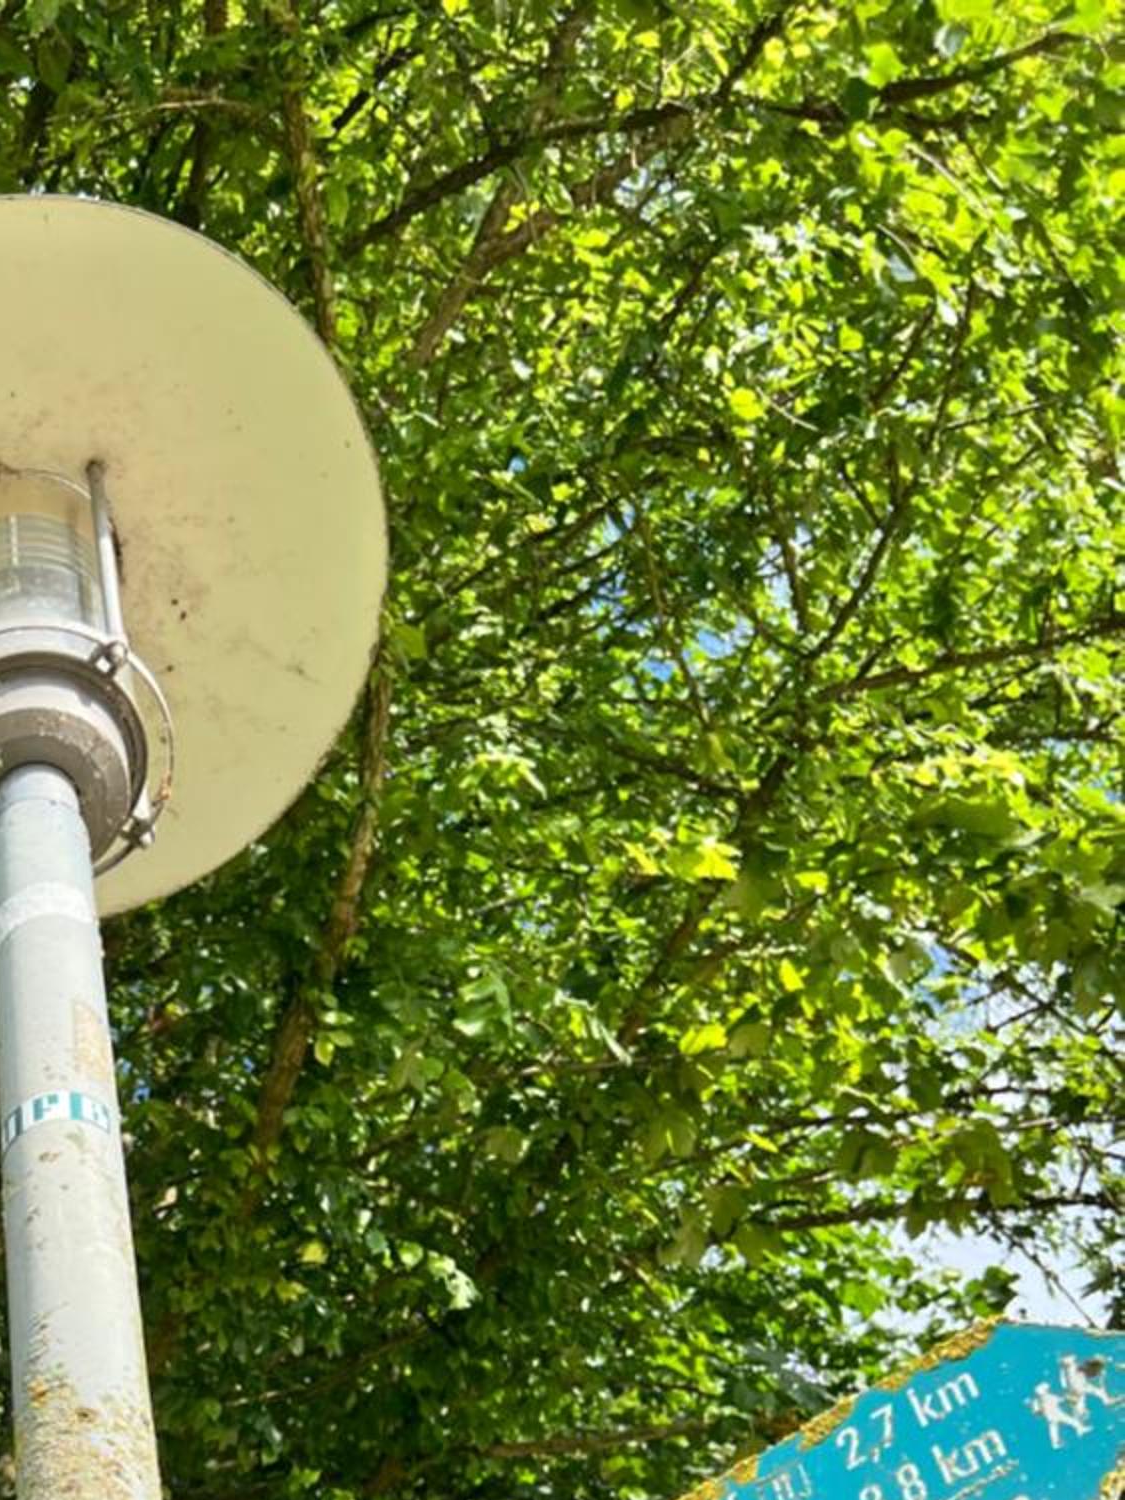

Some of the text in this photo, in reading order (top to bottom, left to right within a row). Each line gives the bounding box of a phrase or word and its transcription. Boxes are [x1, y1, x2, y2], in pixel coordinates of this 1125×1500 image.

[836, 1371, 980, 1471] 2,7 km
[932, 1429, 1008, 1485] km
